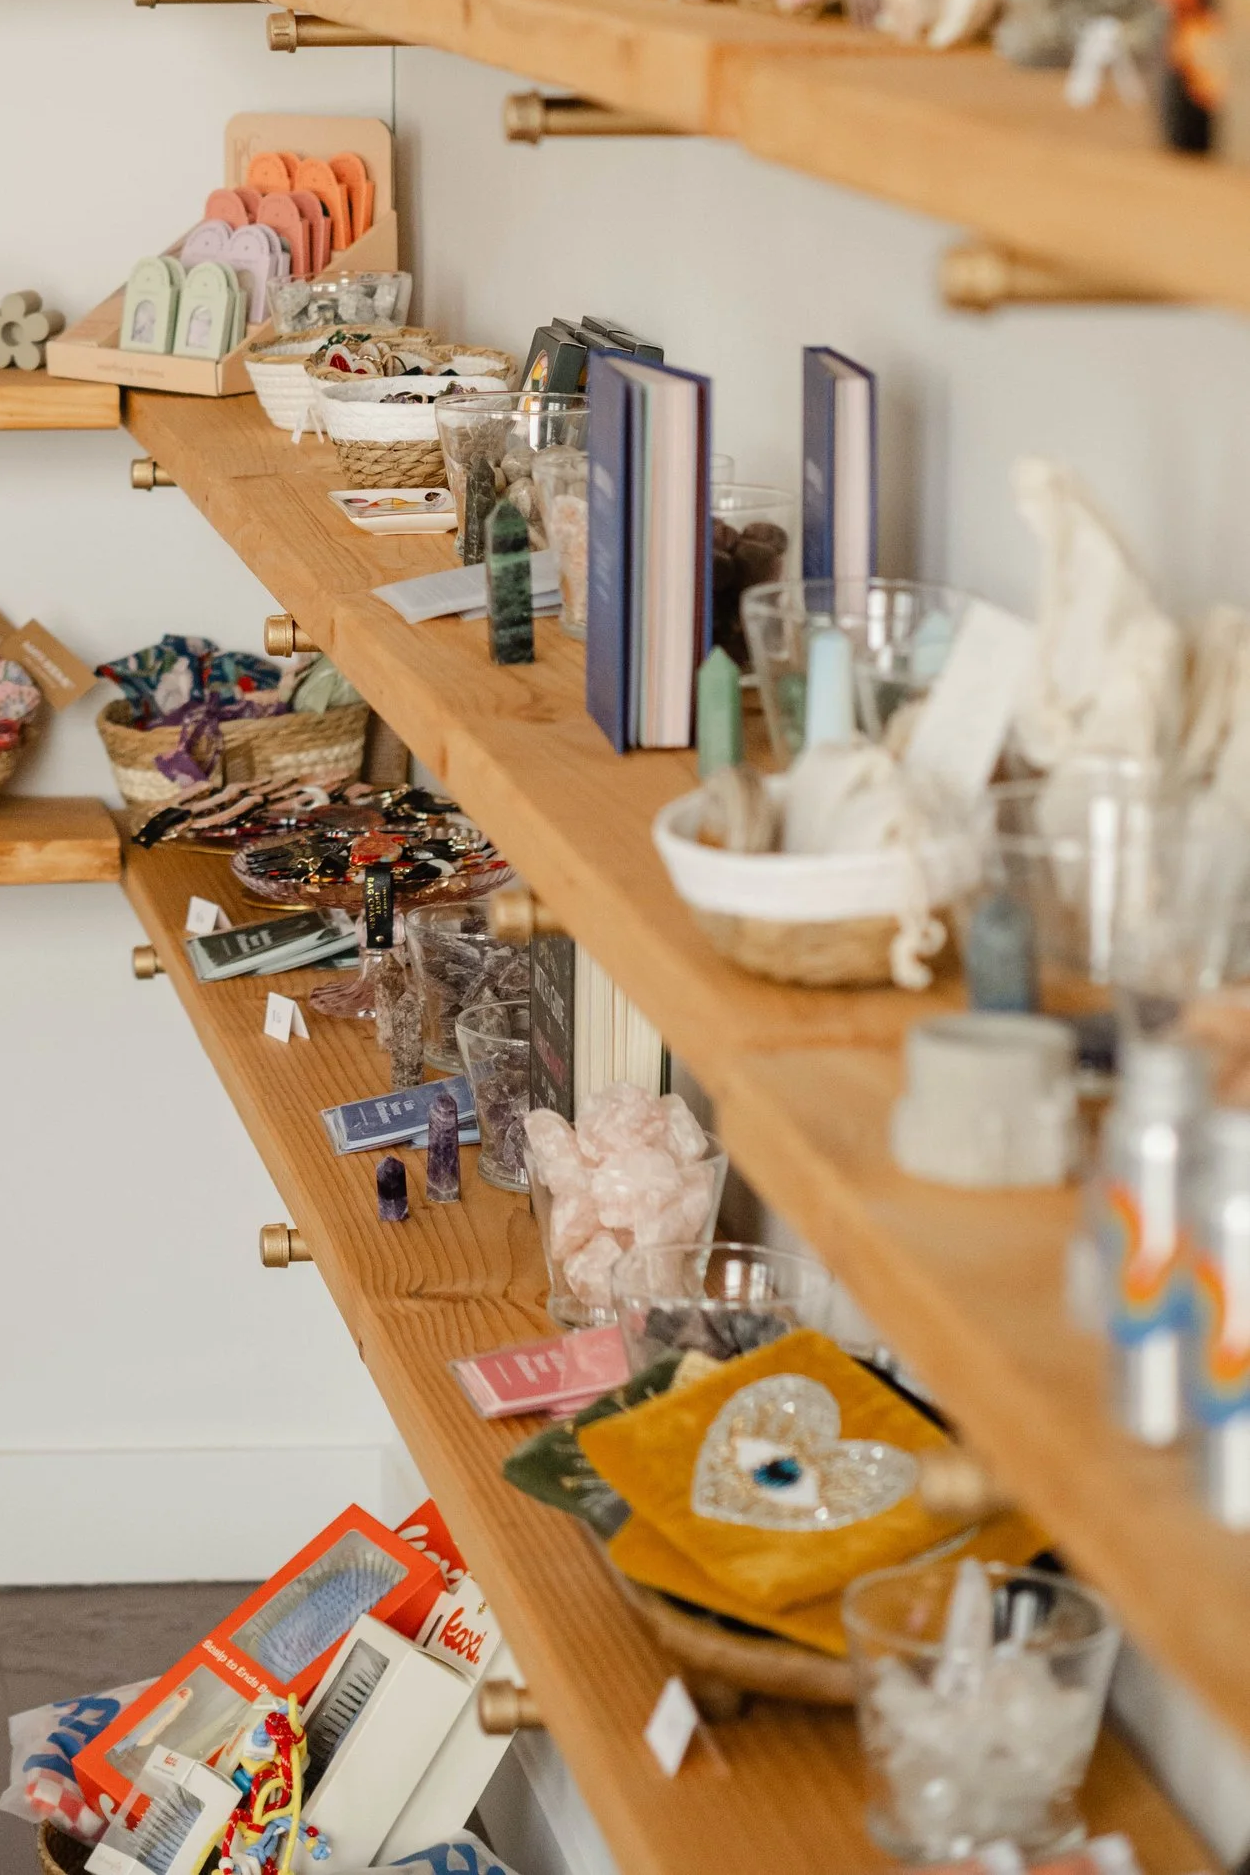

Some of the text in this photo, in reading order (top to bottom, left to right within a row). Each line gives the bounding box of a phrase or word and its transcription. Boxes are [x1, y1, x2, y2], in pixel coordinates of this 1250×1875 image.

[202, 1639, 228, 1662] Scalp
[225, 1659, 238, 1671] to
[235, 1666, 260, 1689] Ends
